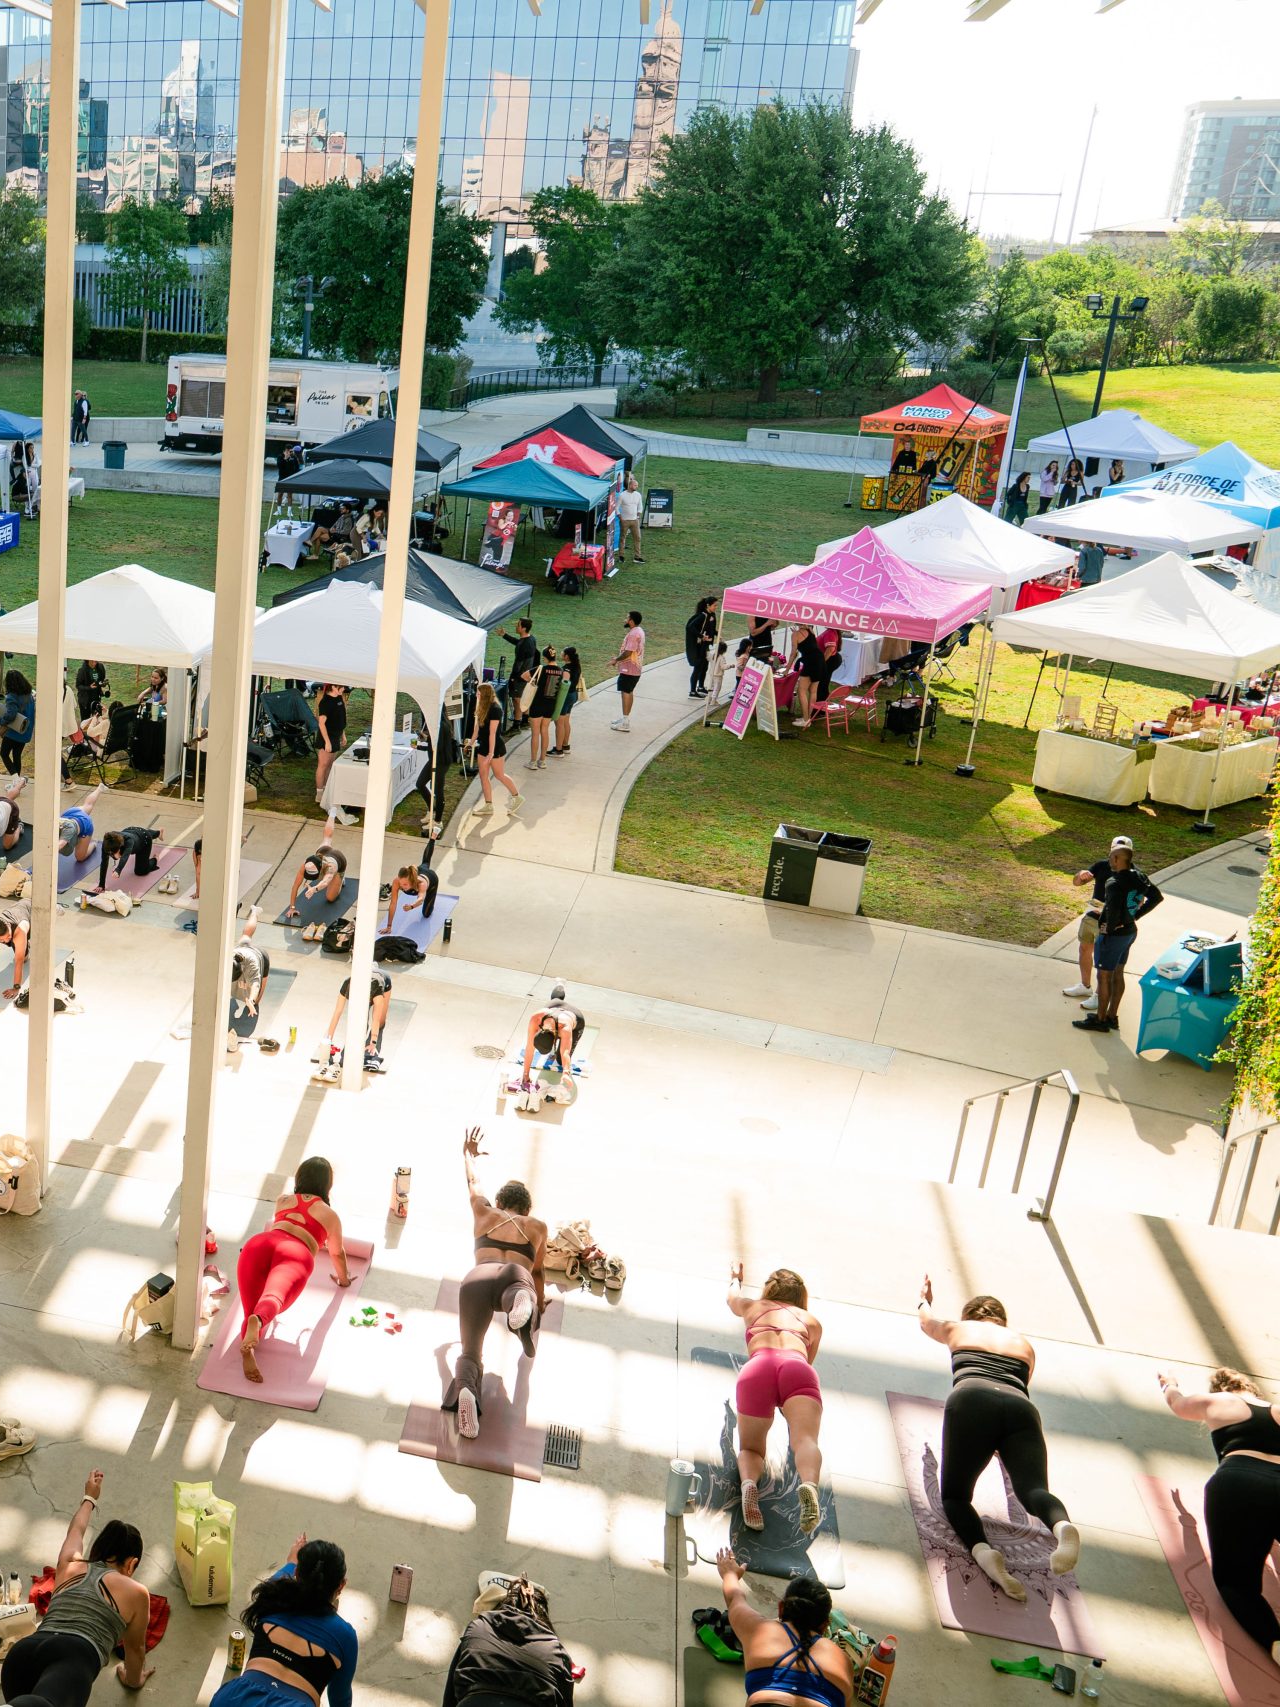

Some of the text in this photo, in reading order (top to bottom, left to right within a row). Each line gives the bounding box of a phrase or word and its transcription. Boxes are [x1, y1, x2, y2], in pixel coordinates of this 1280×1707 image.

[903, 411, 947, 419] FUEGO
[904, 406, 951, 415] MANGO
[893, 422, 944, 434] C4 ENERGY
[1152, 480, 1235, 501] NATURE
[1161, 471, 1241, 490] A FORCE OF
[755, 598, 870, 629] DIVADANCE
[770, 856, 785, 897] recycle.
[207, 1565, 216, 1598] lululemon
